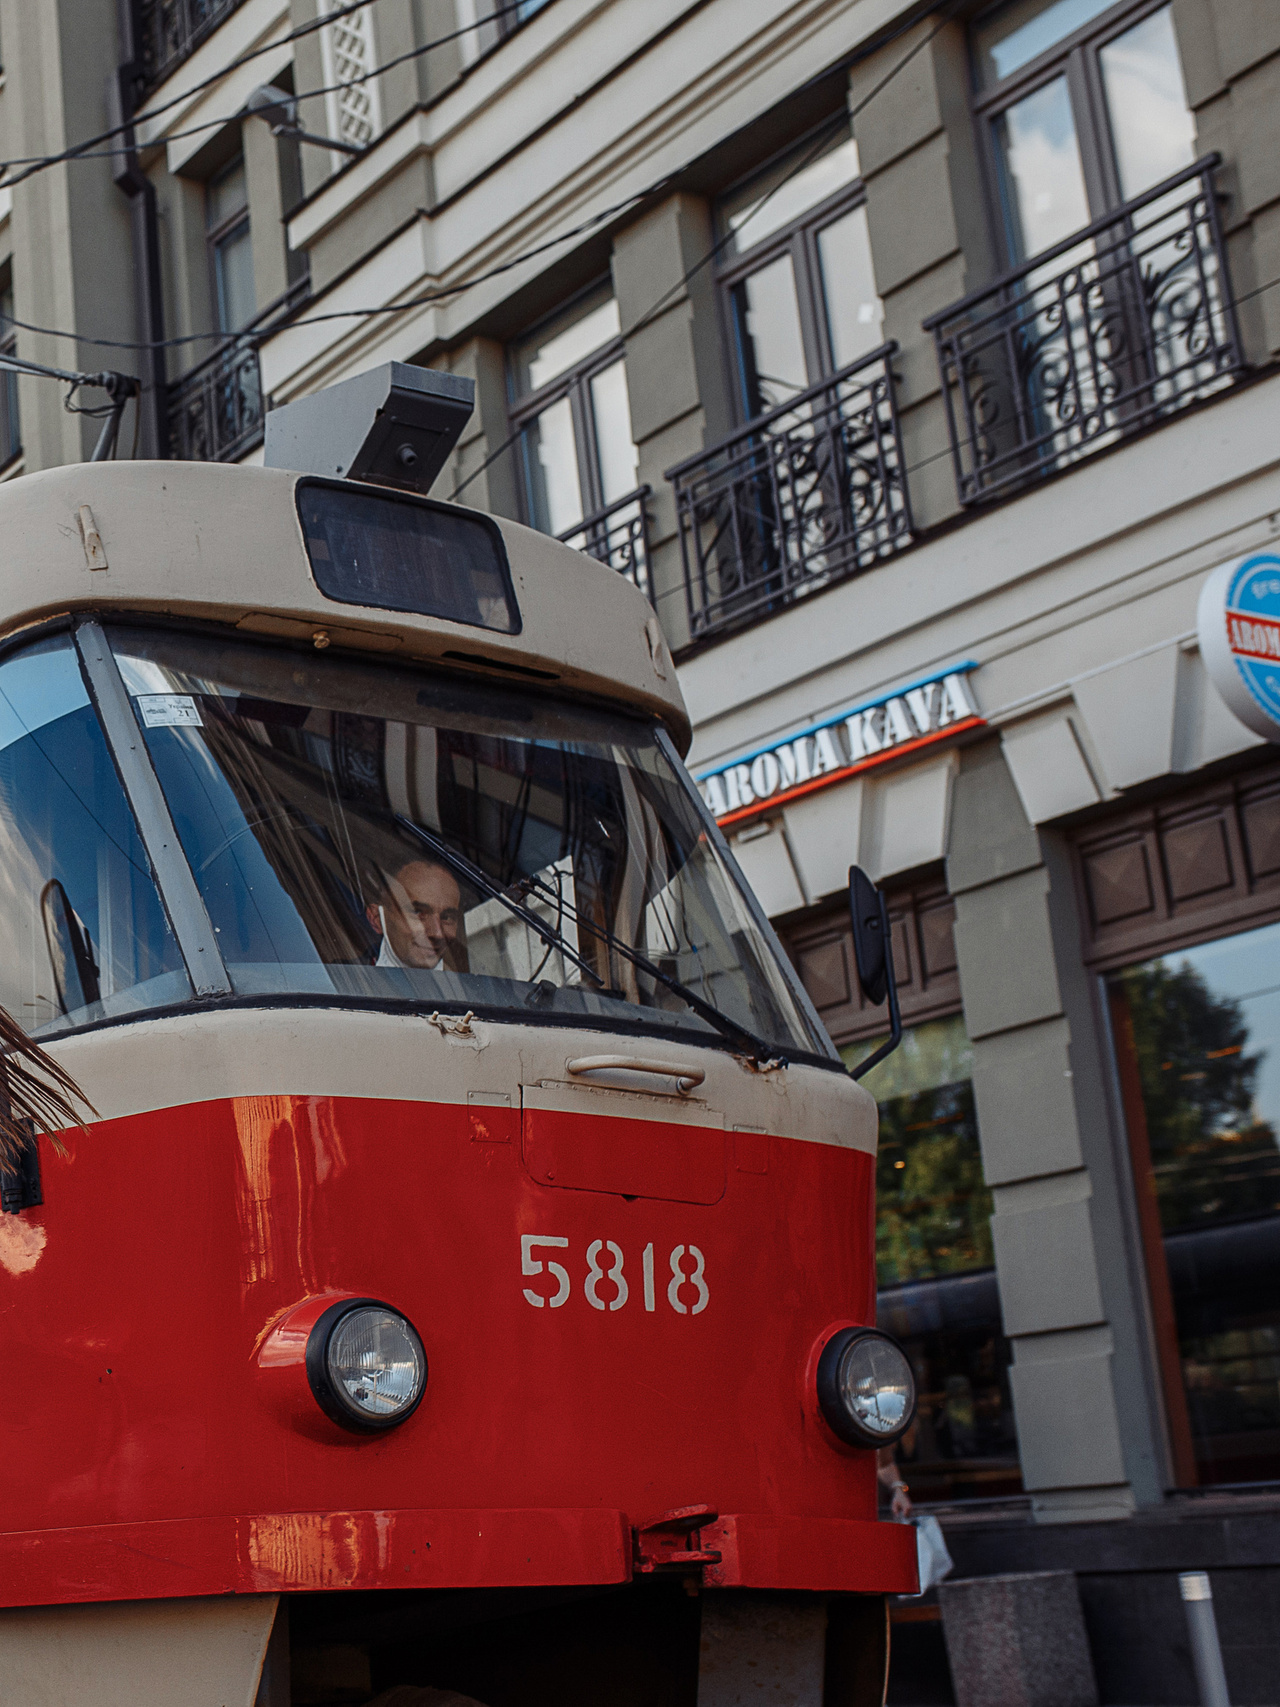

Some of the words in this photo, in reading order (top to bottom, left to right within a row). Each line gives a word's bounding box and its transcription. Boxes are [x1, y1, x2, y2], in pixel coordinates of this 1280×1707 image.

[704, 727, 841, 817] AROMA
[845, 672, 974, 762] KAVA
[520, 1234, 710, 1316] 5818
